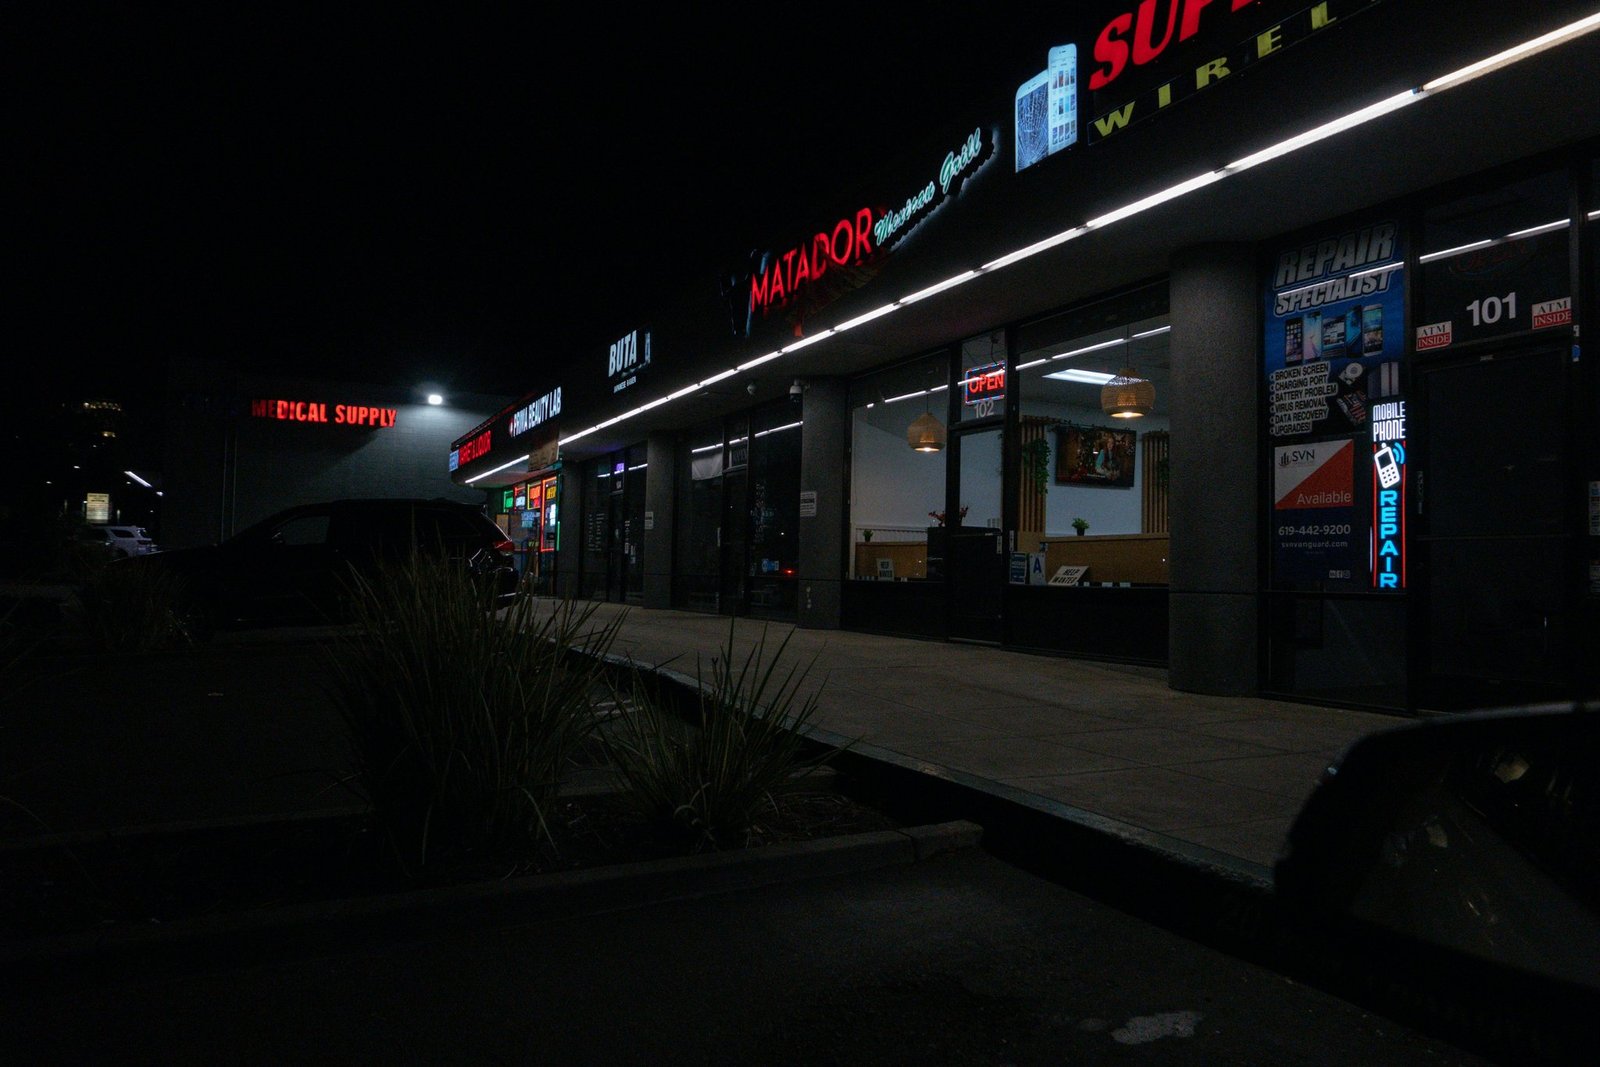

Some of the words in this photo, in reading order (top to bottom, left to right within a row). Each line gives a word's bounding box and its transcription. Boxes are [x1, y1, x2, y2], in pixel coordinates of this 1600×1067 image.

[750, 206, 874, 313] MATADOR
[874, 180, 936, 247] Mexican
[940, 127, 982, 195] Grill
[1274, 222, 1396, 289] REPAIR
[1276, 268, 1392, 316] SPECIALIST
[1466, 291, 1517, 327] 101
[1538, 301, 1568, 314] ATM
[1533, 310, 1572, 328] INSIDE
[1422, 325, 1446, 336] ATM
[1418, 333, 1450, 348] INSIDE
[608, 329, 637, 377] BUTA
[1275, 369, 1301, 381] BROKEN
[1302, 364, 1329, 377] SCREEN
[968, 372, 1005, 394] OPEN
[1275, 378, 1308, 392] CHARGING
[1309, 374, 1328, 386] PORT
[1275, 389, 1304, 402] BATTERY
[1304, 384, 1337, 399] PROBLEM
[549, 386, 562, 419] LAB
[974, 400, 995, 419] 102
[1275, 401, 1294, 413] VIRUS
[1294, 398, 1327, 410] REMOVAL
[1372, 400, 1406, 421] MOBILE
[251, 399, 328, 423] MEDICAL
[334, 404, 398, 428] SUPPLY
[1275, 413, 1292, 424] DATA
[1293, 407, 1328, 421] RECOVERY
[1275, 422, 1311, 435] UPGRADES!
[1372, 418, 1407, 442] PHONE
[1292, 449, 1315, 462] SVN
[1296, 491, 1352, 505] Available
[1278, 524, 1351, 536] 619-442-9200
[1379, 489, 1399, 589] REPAIR
[1033, 557, 1042, 574] A
[1063, 568, 1081, 576] HELP
[1051, 576, 1078, 584] WANTED
